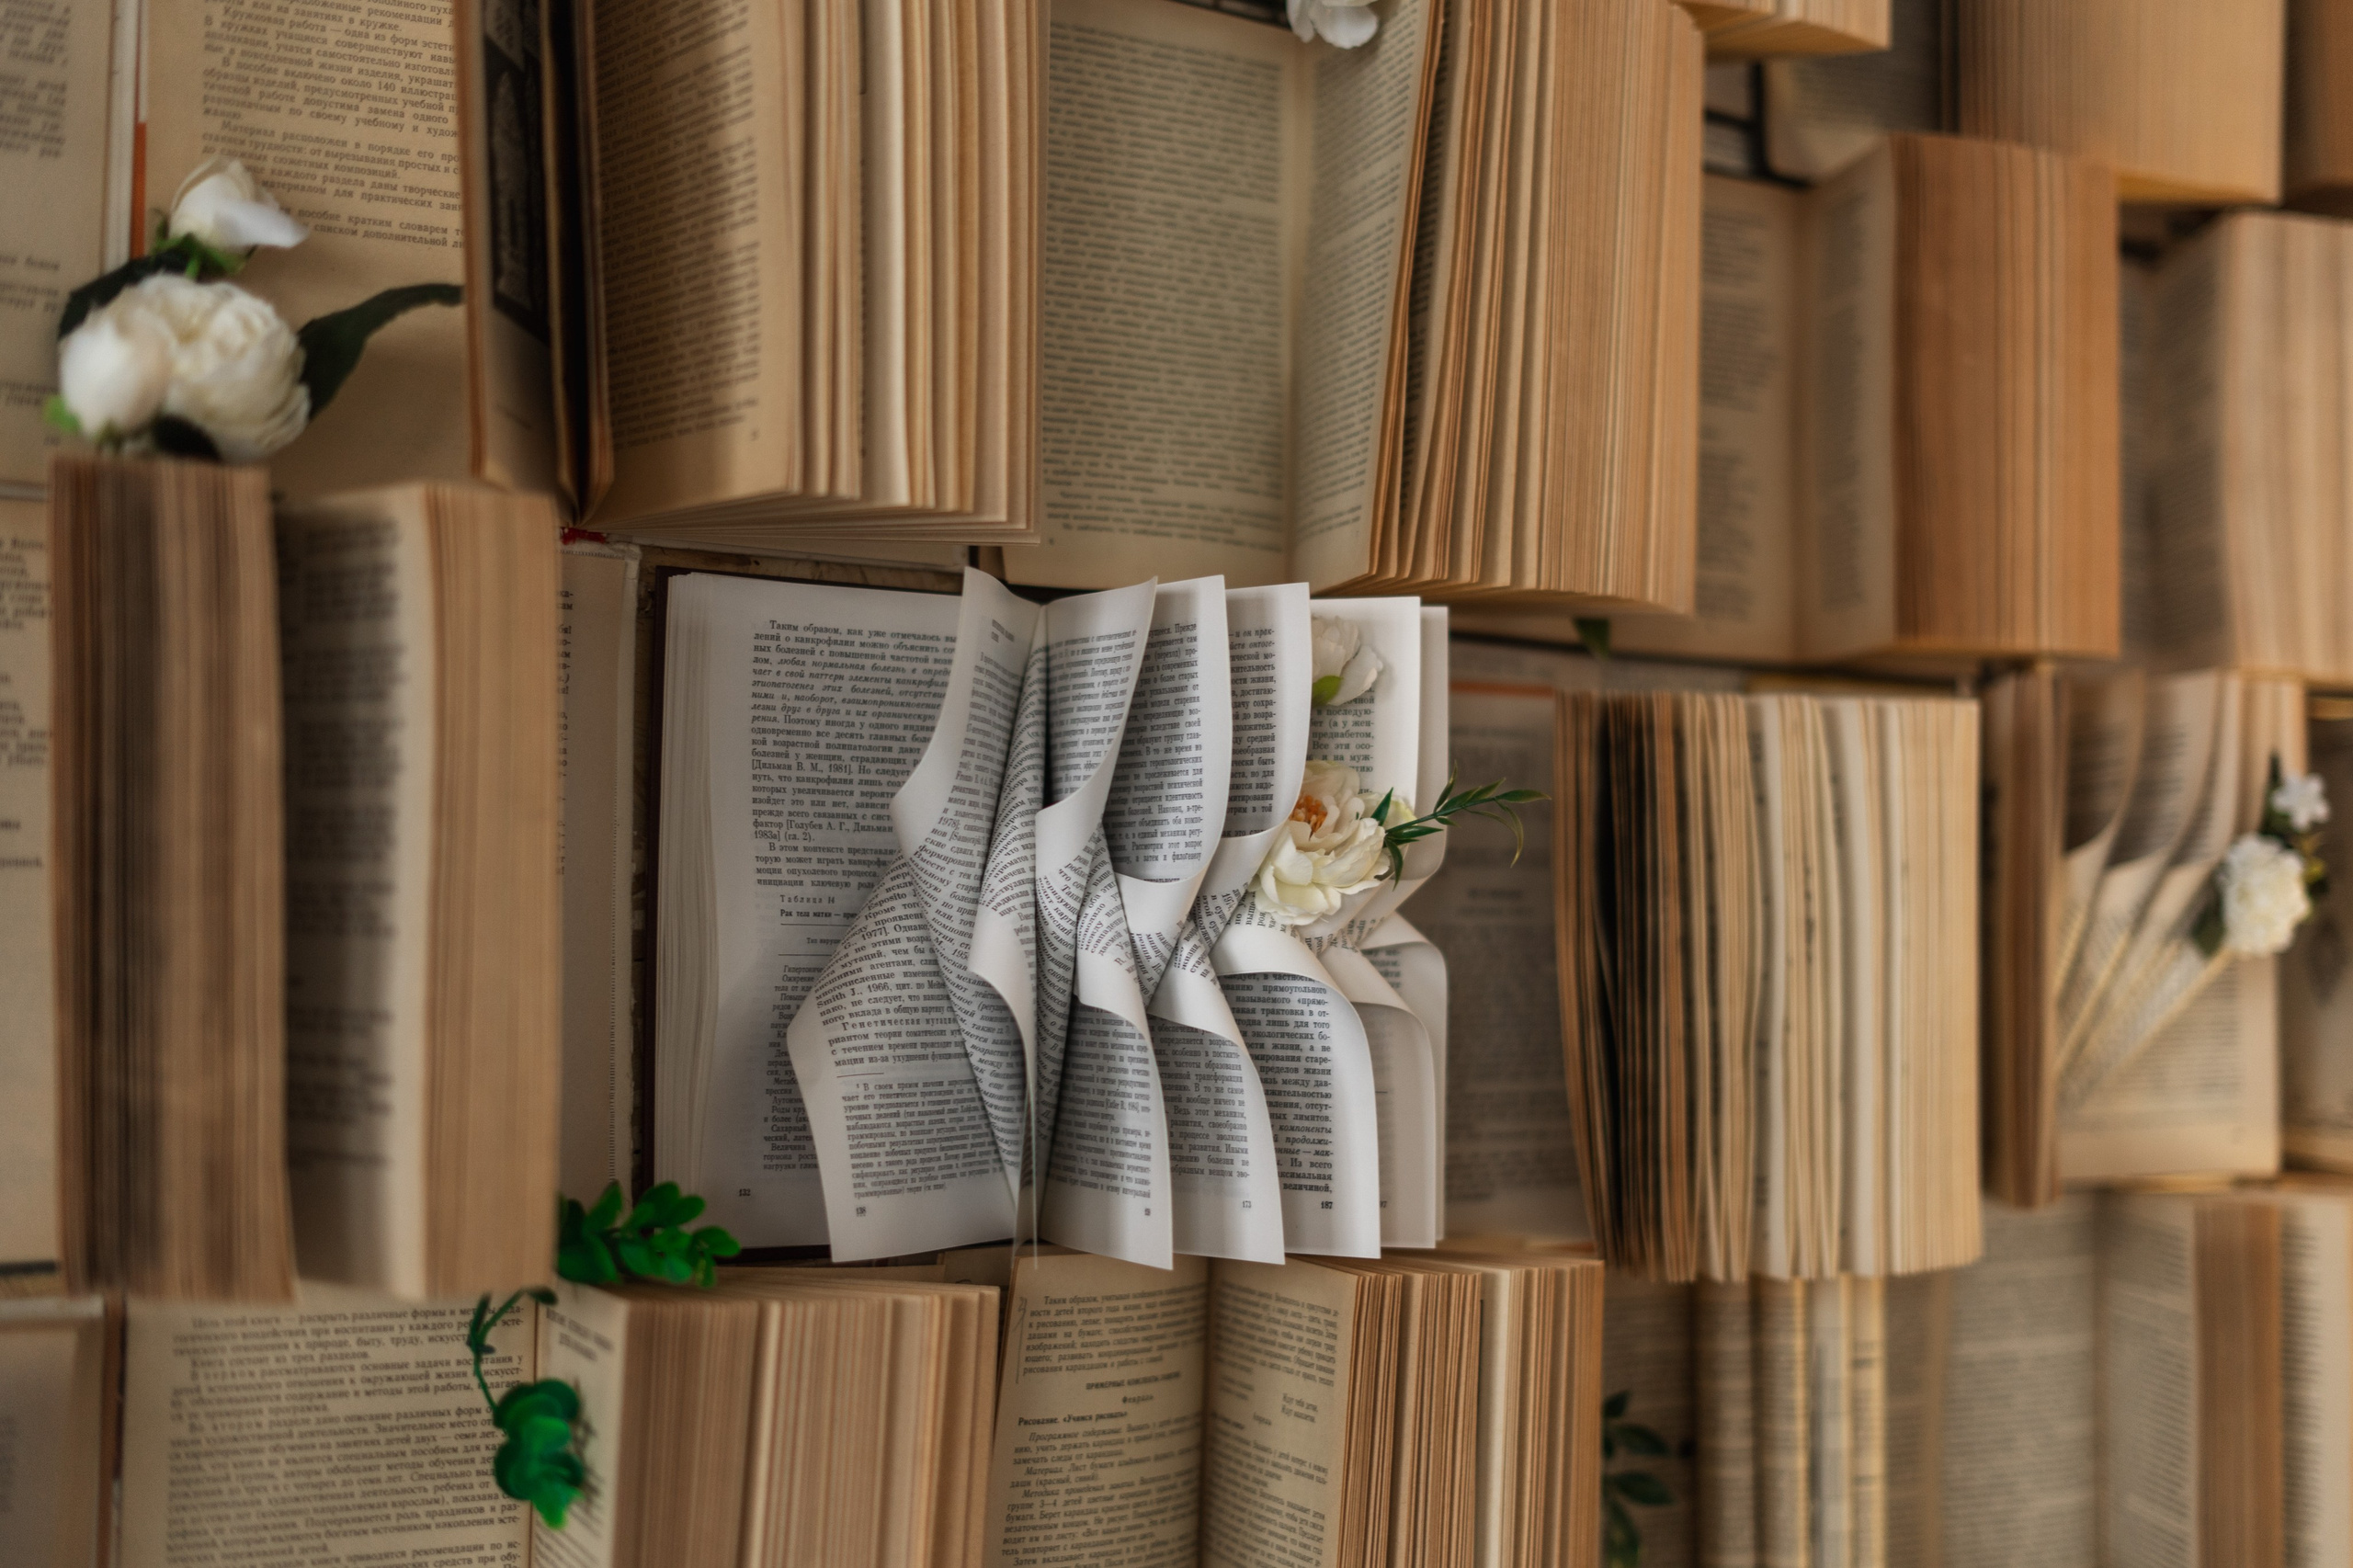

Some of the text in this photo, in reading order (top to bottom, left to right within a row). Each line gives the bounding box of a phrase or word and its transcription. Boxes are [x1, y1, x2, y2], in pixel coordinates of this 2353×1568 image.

[368, 7, 442, 26] рекомендации
[359, 18, 402, 31] кружке.
[345, 28, 417, 47] одна из форм
[335, 40, 423, 59] совершенствуют
[358, 67, 404, 82] изделия,
[341, 77, 396, 92] около 140
[369, 106, 449, 124] замена одного
[356, 118, 404, 133] учебному
[369, 143, 435, 158] порядке его
[325, 150, 441, 173] вырезывания простых
[335, 164, 402, 179] композиций.
[323, 174, 398, 192] раздела даны
[361, 191, 432, 207] практических
[349, 214, 448, 234] кратким словарем
[363, 229, 448, 247] дополнительной
[770, 620, 798, 632] Таким
[803, 623, 842, 637] образом,
[869, 631, 885, 640] уже
[892, 633, 941, 642] отмечалось
[754, 632, 780, 642] лений
[795, 635, 856, 649] канкрофилии
[893, 642, 939, 653] объяснить
[776, 644, 815, 655] болезней
[830, 650, 886, 661] повышенной
[892, 653, 930, 664] частотой
[754, 657, 906, 674] лом, любая нормальная болезнь
[1240, 688, 1276, 697] достигаю-
[782, 694, 790, 702] и,
[795, 694, 837, 706] наоборот,
[842, 697, 941, 710] взаимопроникновение
[781, 702, 801, 714] друг
[816, 704, 840, 717] друга
[872, 710, 936, 722] органическую
[1326, 710, 1374, 718] последую-
[752, 714, 899, 731] рения. Поэтому иногда у одного
[1329, 718, 1338, 729] (а
[1342, 721, 1347, 729] у
[1313, 730, 1375, 740] предиабетом,
[1313, 740, 1330, 749] Все
[753, 759, 791, 772] [Дильман
[797, 762, 804, 771] В.
[829, 763, 853, 775] 1981].
[858, 765, 870, 774] Но
[876, 767, 911, 778] следует
[753, 796, 785, 805] изойдет
[833, 801, 848, 809] нет,
[754, 819, 783, 830] фактор
[786, 818, 824, 832] [Голубев
[826, 821, 835, 831] А.
[853, 823, 892, 833] Дильман
[755, 830, 780, 841] 1983а]
[769, 842, 776, 851] В
[803, 846, 844, 854] контексте
[780, 893, 824, 903] Таблица
[816, 990, 847, 1008] Smith
[868, 982, 892, 993] 1966,
[1236, 995, 1328, 1006] называемого «прямо-
[822, 1015, 845, 1027] ного
[849, 1009, 882, 1019] вклада
[893, 1005, 919, 1016] общую
[1261, 1008, 1304, 1017] трактовка
[828, 1032, 870, 1047] риантом
[1252, 1030, 1330, 1040] экологических бо-
[1260, 1066, 1299, 1074] пределов
[1293, 1114, 1332, 1122] лимитов.
[1279, 1124, 1332, 1133] компоненты
[1290, 1158, 1332, 1169] Из всего
[739, 1188, 751, 1198] 132
[1283, 1183, 1333, 1194] величиной,
[1321, 1201, 1333, 1210] 187
